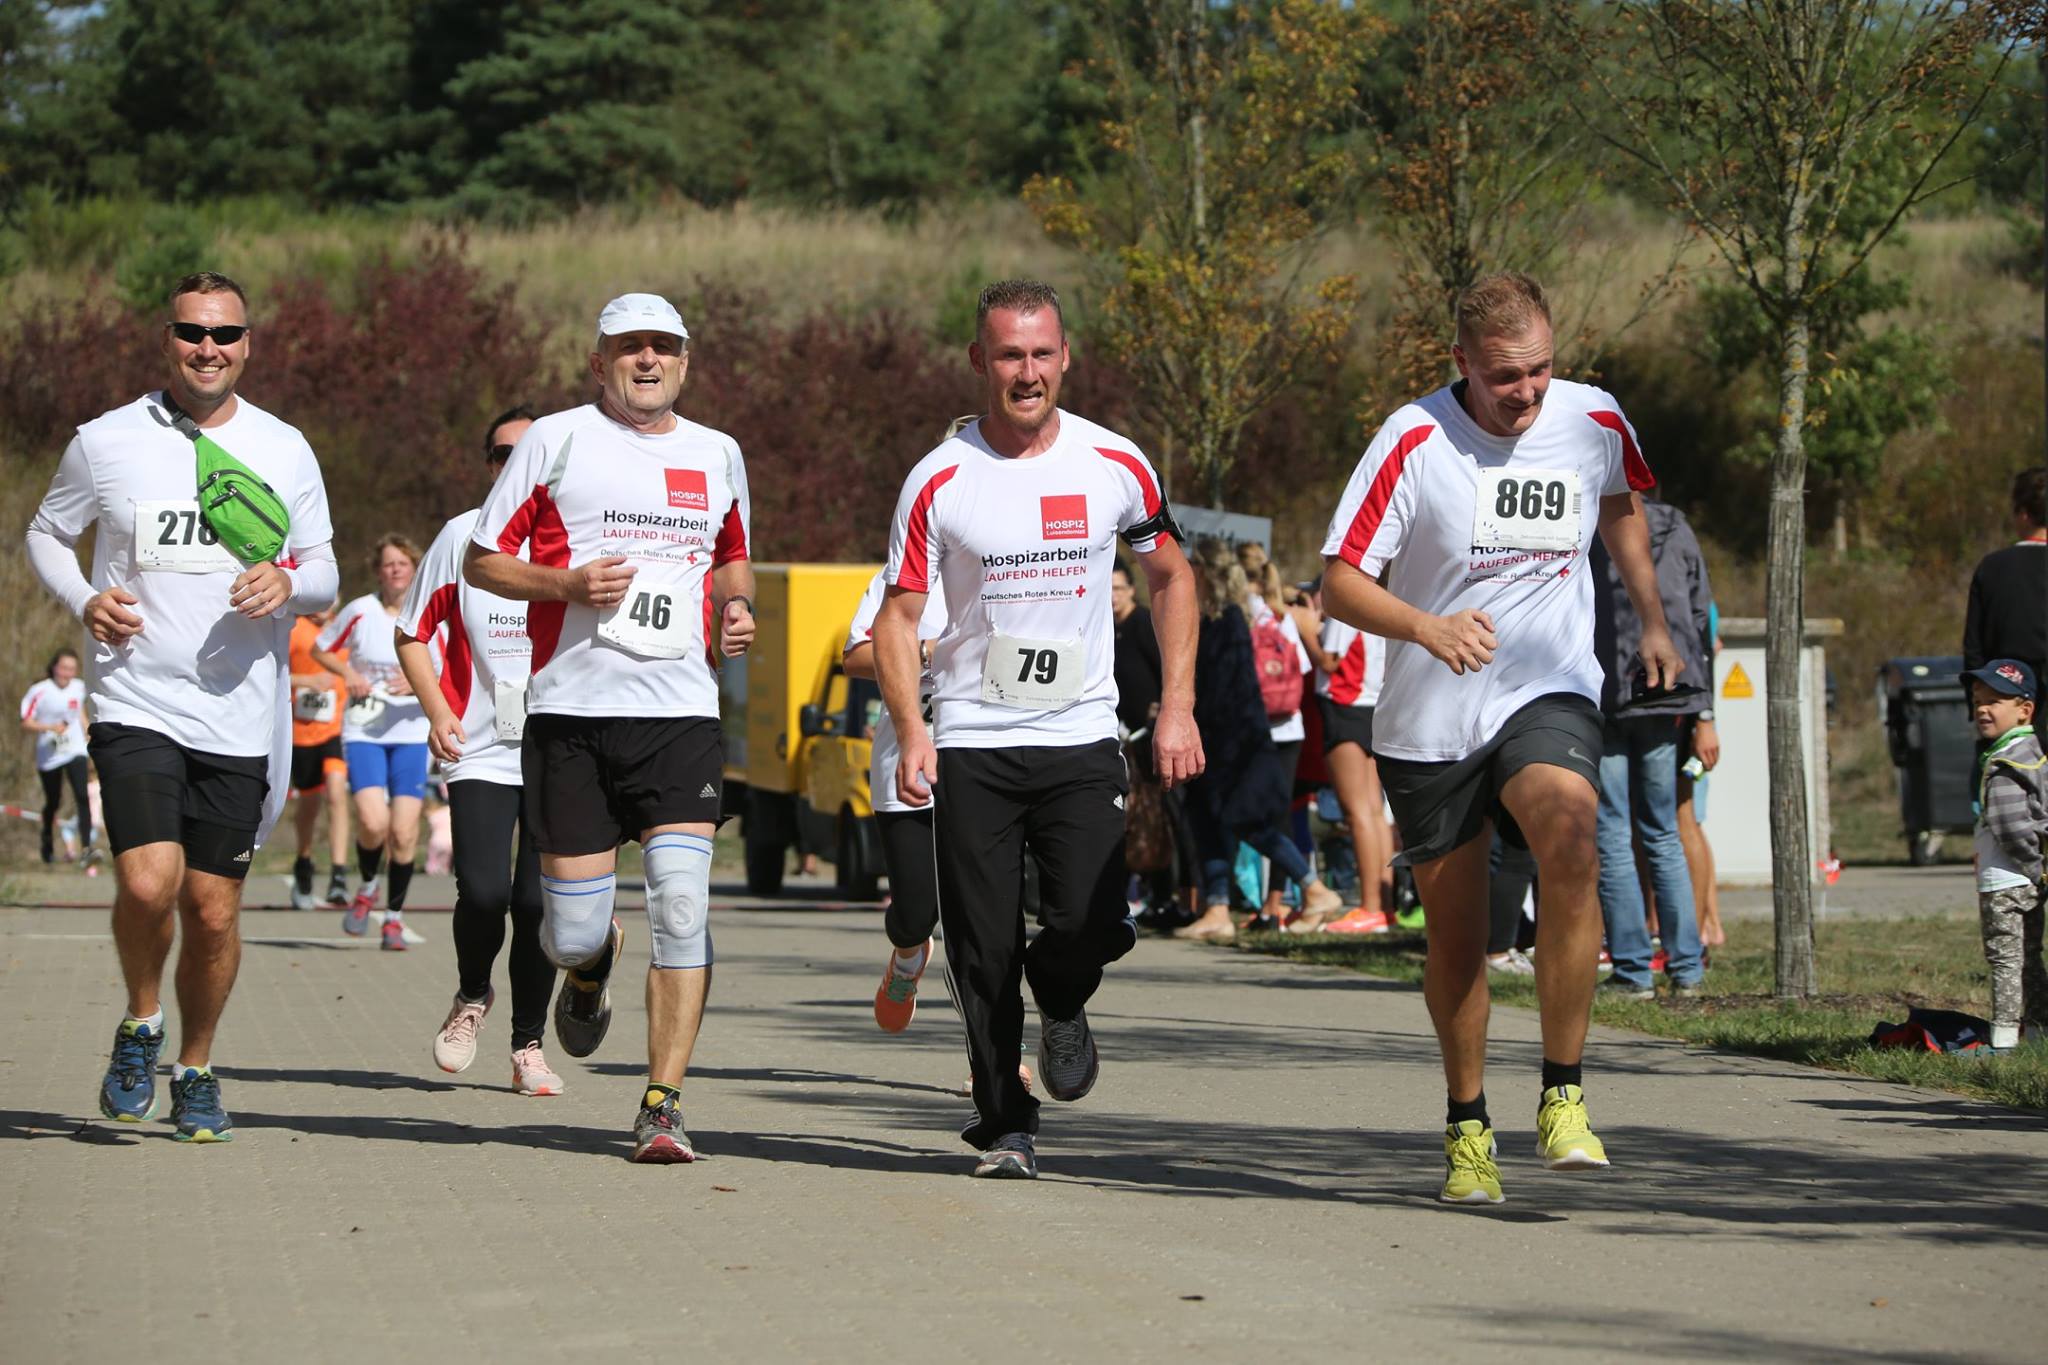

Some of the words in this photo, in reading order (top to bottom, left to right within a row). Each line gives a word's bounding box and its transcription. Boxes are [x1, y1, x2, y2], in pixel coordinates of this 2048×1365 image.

[670, 490, 706, 502] HOSPIZ
[1495, 478, 1566, 521] 869
[603, 510, 709, 533] Hospizarbeit
[1045, 519, 1085, 530] HOSPIZ
[603, 529, 658, 541] LAUFEND
[662, 532, 705, 546] HELFEN
[981, 547, 1088, 568] Hospizarbeit
[1470, 554, 1528, 571] LAUFEND
[1042, 565, 1087, 578] HELFEN
[981, 591, 1023, 601] Deutsches
[1024, 590, 1048, 599] Rotes
[1050, 588, 1073, 597] Kreuz
[629, 591, 672, 631] 46
[1017, 648, 1059, 685] 79
